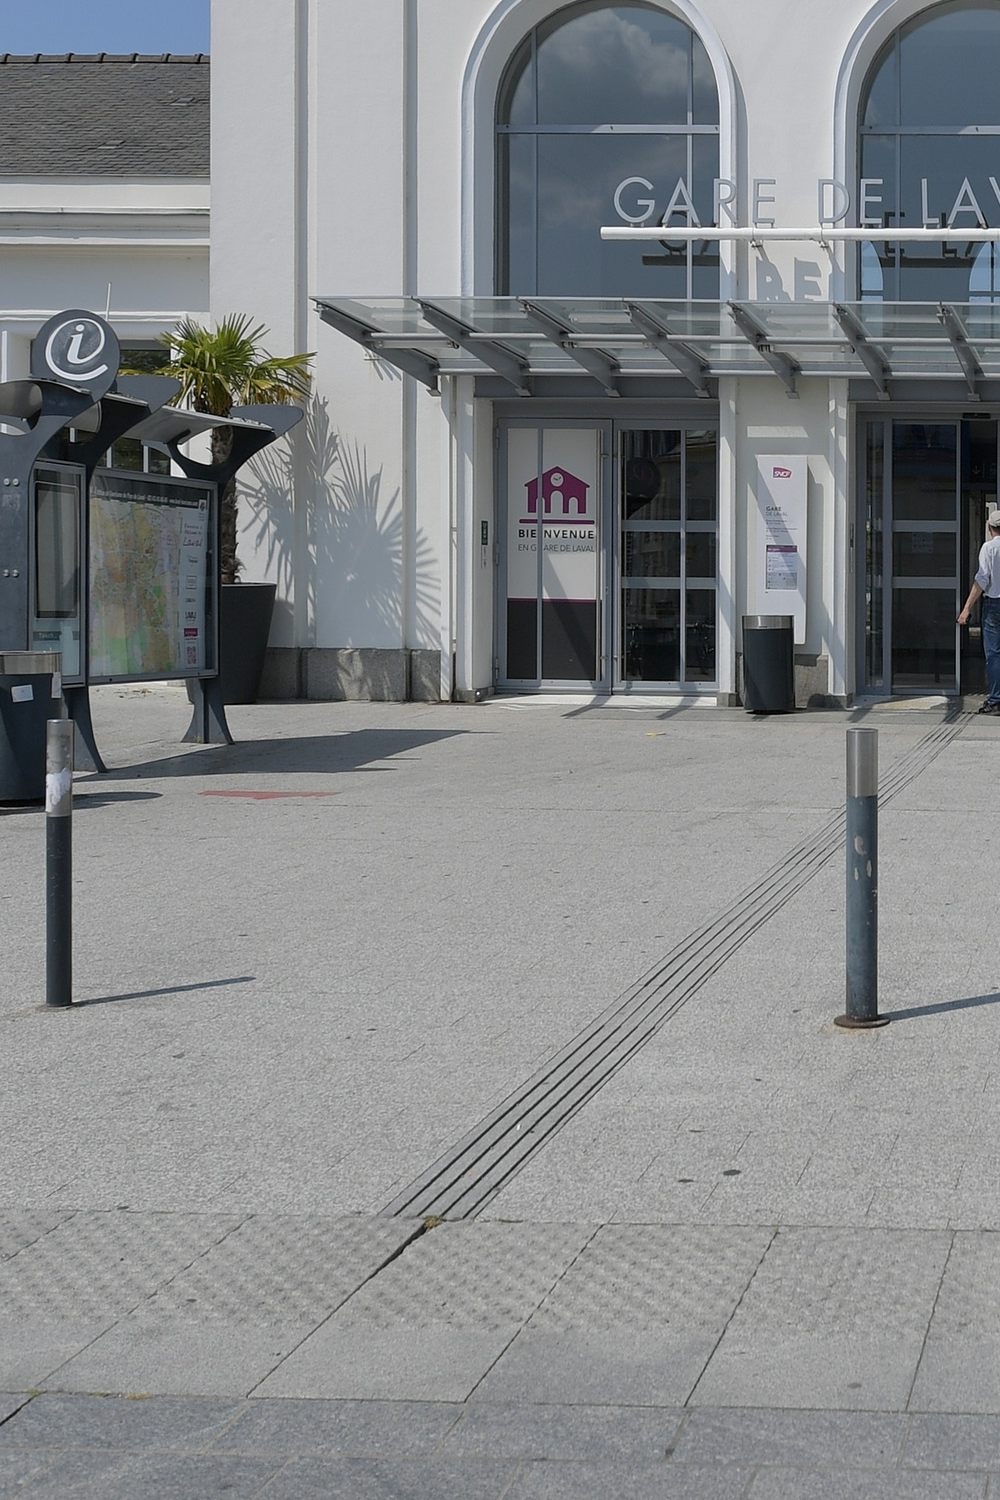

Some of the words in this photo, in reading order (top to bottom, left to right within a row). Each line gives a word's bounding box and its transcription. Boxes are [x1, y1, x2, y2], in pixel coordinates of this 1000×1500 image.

[613, 176, 776, 224] GARE
[818, 178, 884, 224] DE
[518, 529, 595, 540] BIENVENUE
[518, 544, 529, 552] EN
[530, 544, 558, 552] GARE
[560, 544, 571, 553] DE
[572, 544, 595, 553] LAVAL
